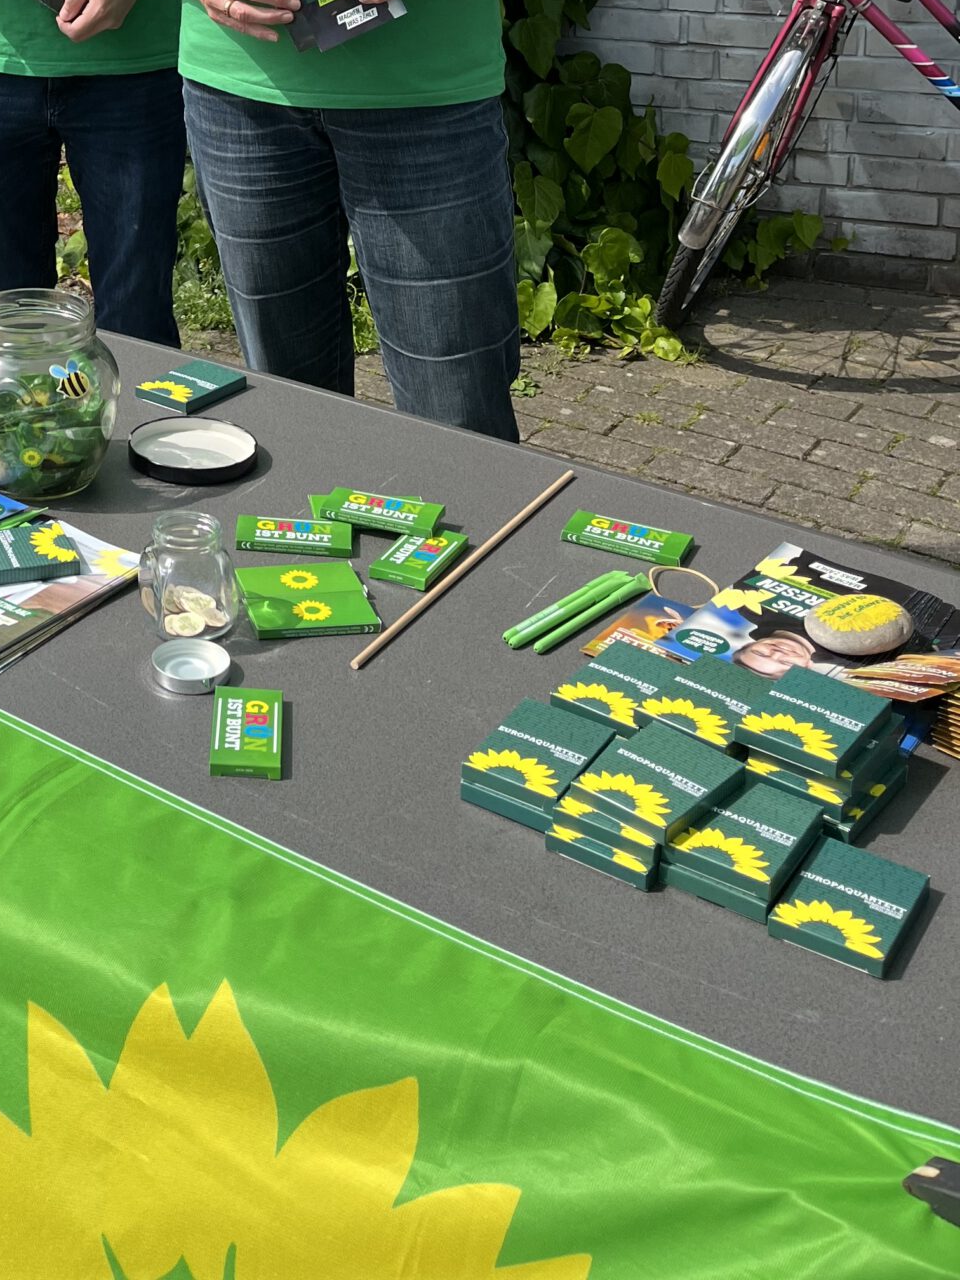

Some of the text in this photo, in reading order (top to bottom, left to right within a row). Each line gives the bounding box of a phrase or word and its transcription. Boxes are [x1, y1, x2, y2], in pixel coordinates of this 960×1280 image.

[342, 501, 418, 521] IST BUNT
[255, 529, 332, 542] IST BUNT
[583, 524, 614, 537] IST
[615, 532, 664, 549] BUNT
[756, 578, 826, 606] RESEN
[588, 662, 659, 693] EUROPAQUART
[674, 675, 753, 711] EUROPAQUARTE
[224, 698, 243, 751] IST BUNT
[769, 690, 865, 727] EUROPAQUARTETT
[498, 724, 588, 763] EUROPAQUARTETT
[617, 747, 709, 789] EUROPAQUARTETT
[712, 806, 797, 840] ROPAQUARTETT
[800, 870, 907, 913] EUROPAQUARTETT
